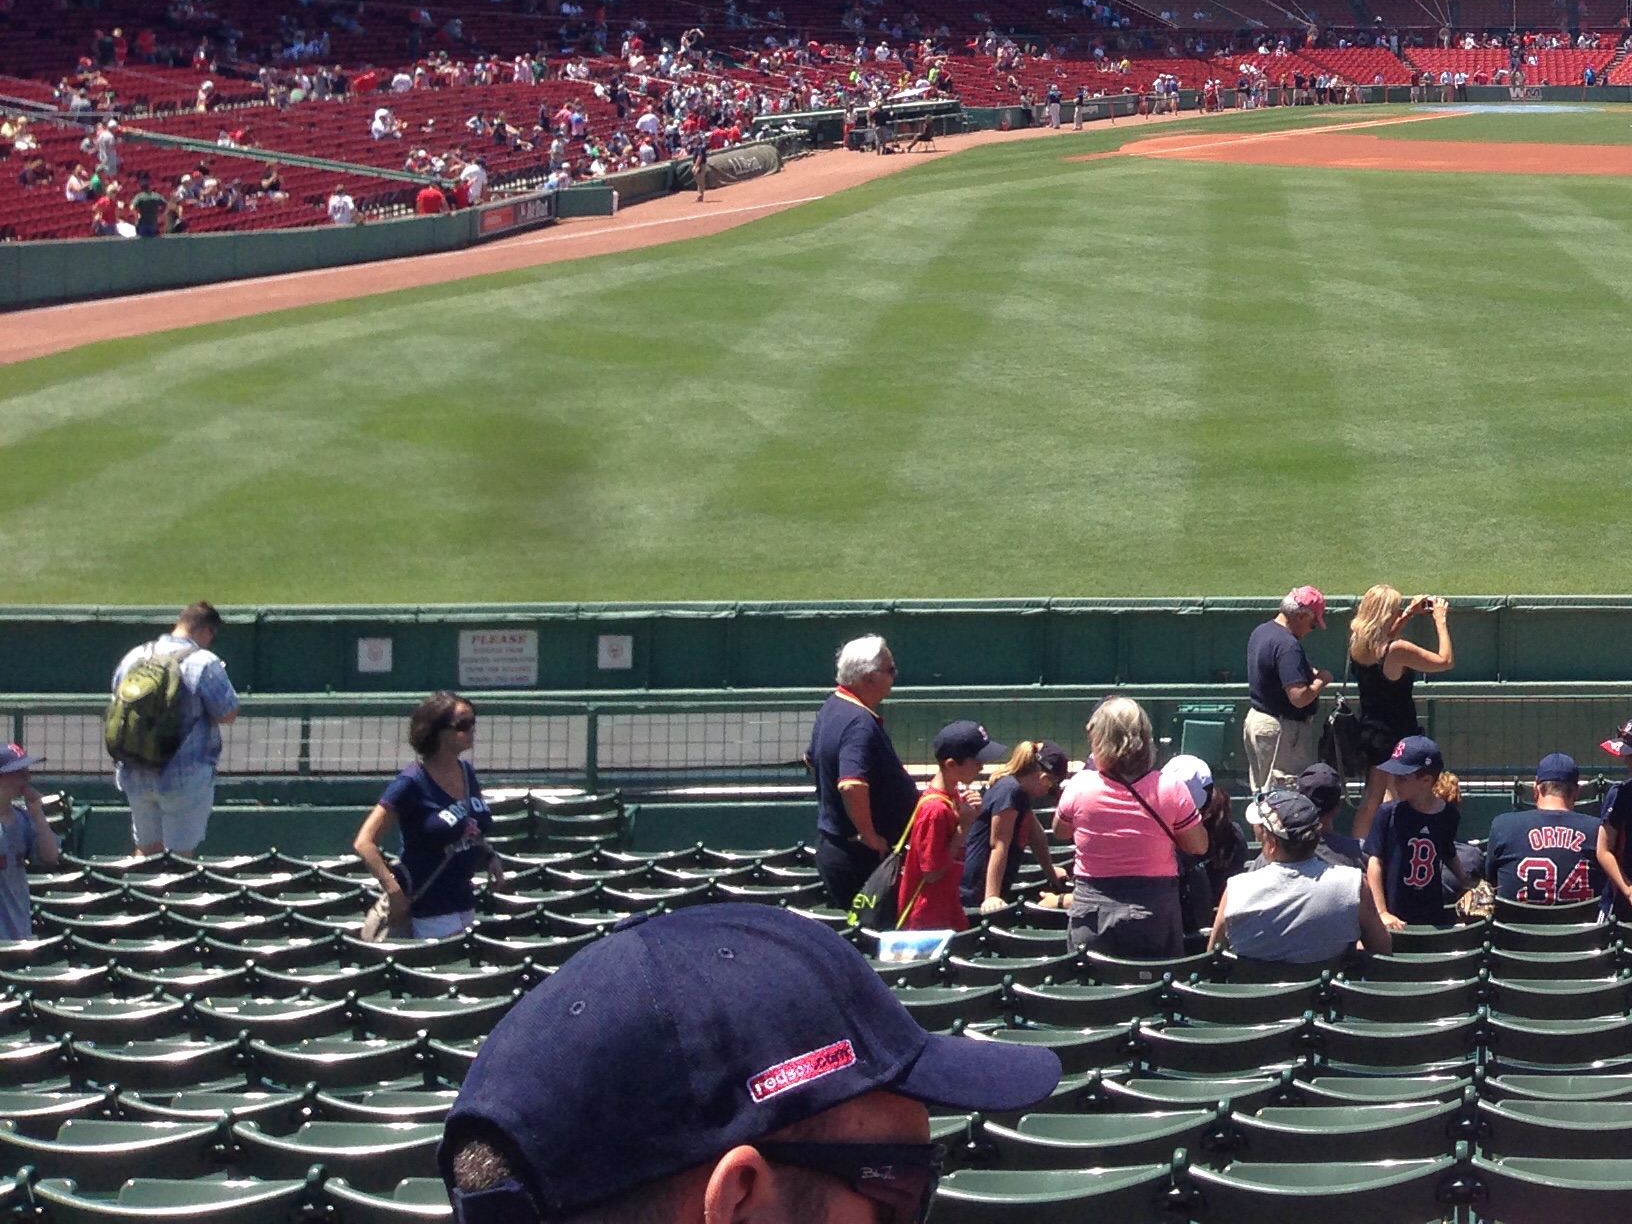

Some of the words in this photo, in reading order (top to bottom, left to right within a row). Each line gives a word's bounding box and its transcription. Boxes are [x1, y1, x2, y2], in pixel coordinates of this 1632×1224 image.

[471, 634, 527, 644] PLEASE
[1403, 837, 1438, 887] B
[1528, 826, 1587, 852] ORTIZ
[1517, 857, 1595, 907] 34
[754, 1047, 853, 1096] redsox.com
